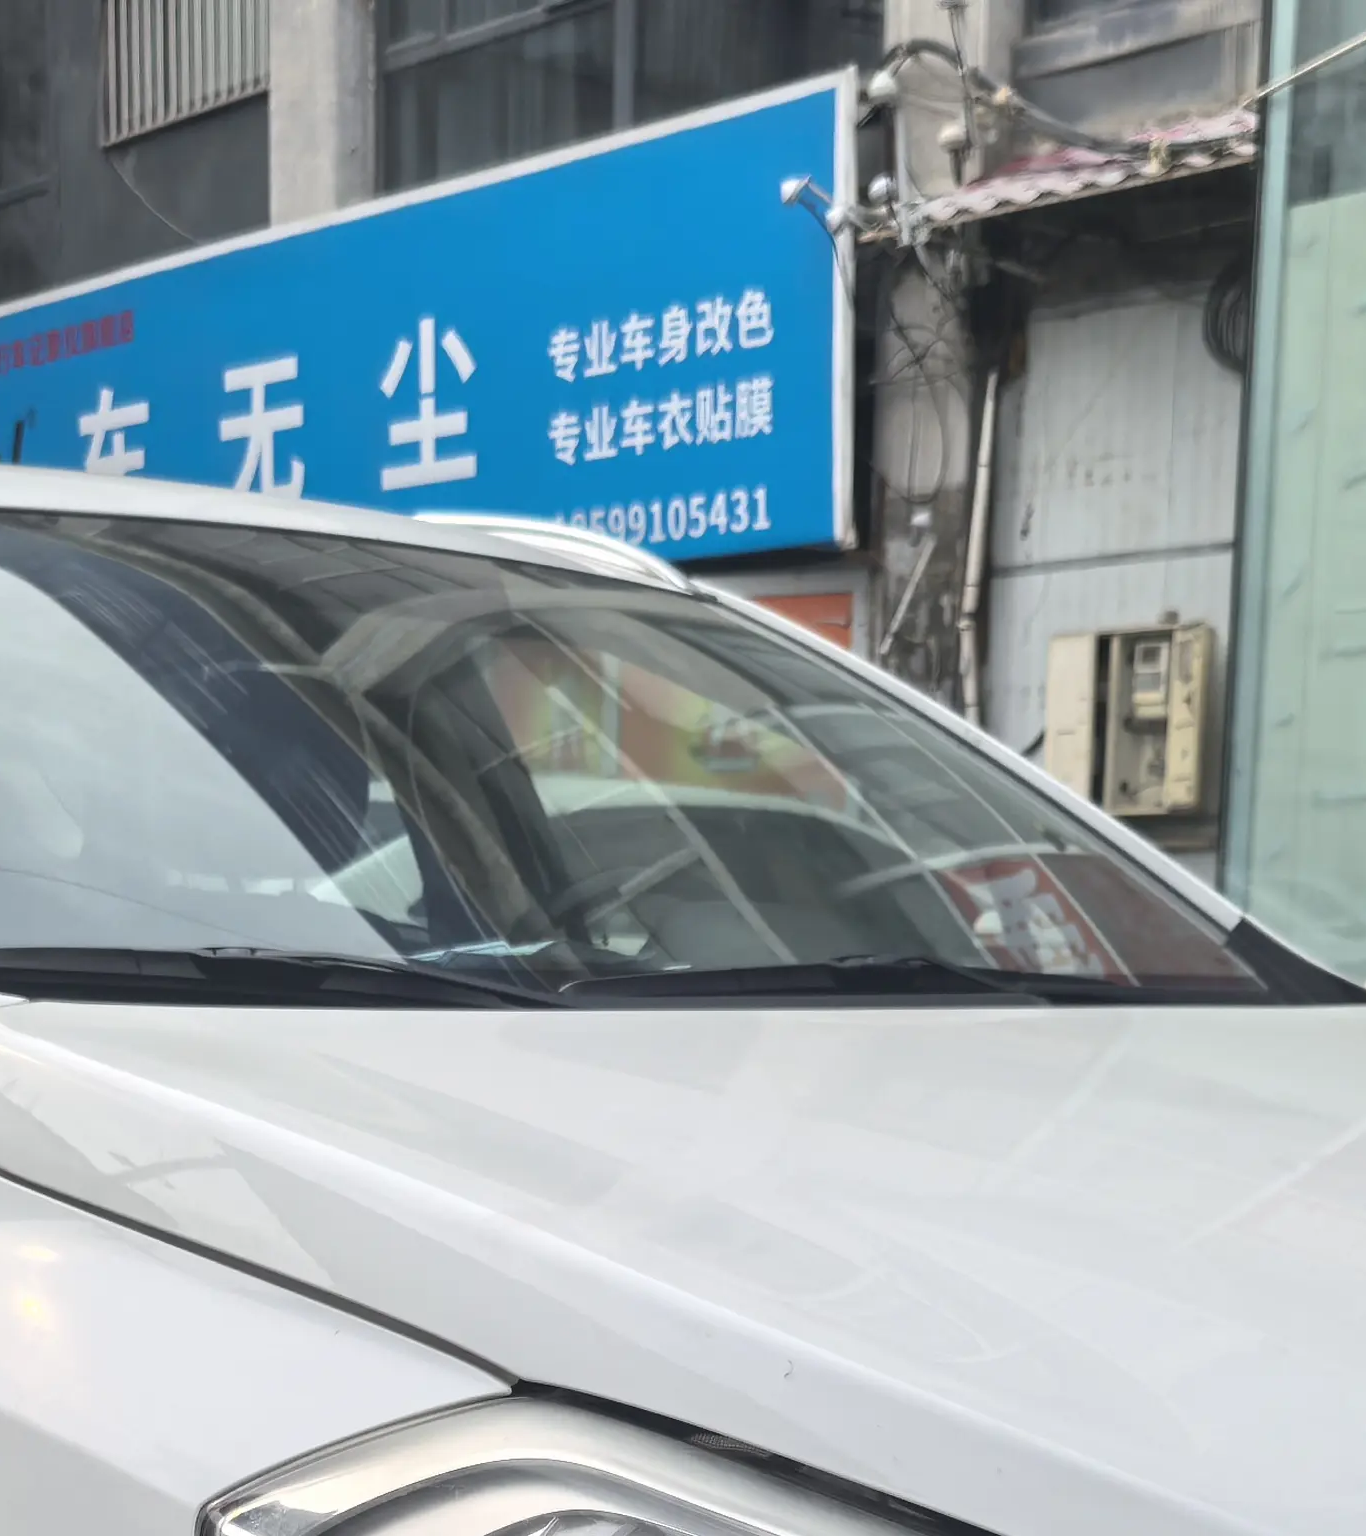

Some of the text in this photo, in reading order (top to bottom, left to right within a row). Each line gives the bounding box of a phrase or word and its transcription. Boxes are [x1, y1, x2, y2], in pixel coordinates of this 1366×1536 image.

[547, 288, 775, 383] 专业车身改色
[547, 374, 774, 467] 专业车衣贴膜
[554, 484, 772, 545] 599105431
